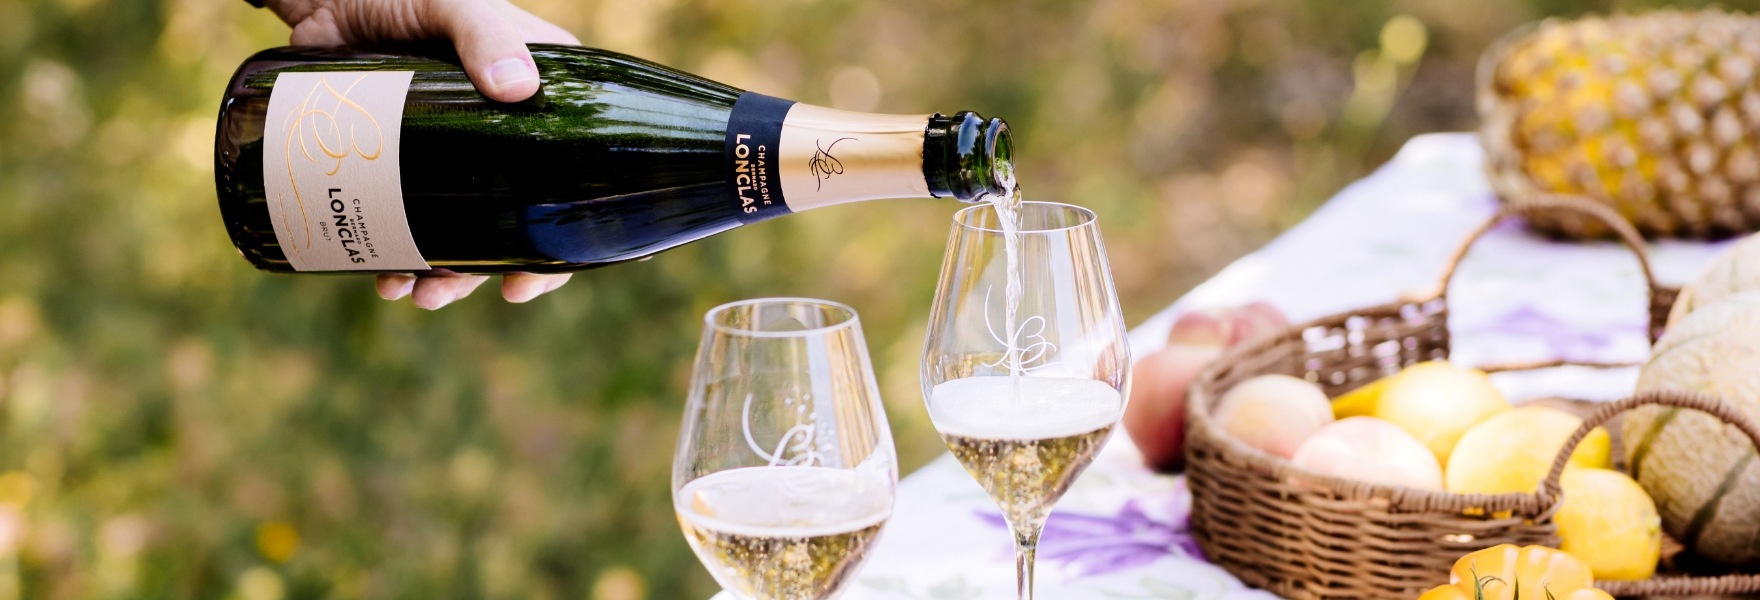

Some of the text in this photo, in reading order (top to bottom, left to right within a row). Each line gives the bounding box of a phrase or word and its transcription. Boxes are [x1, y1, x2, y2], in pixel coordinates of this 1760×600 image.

[735, 133, 758, 214] LONCLAS
[757, 144, 772, 206] CHAMPAGNE
[319, 221, 332, 241] BRUT
[328, 188, 366, 264] LONCLAS
[352, 198, 379, 259] CHAMPAGNE
